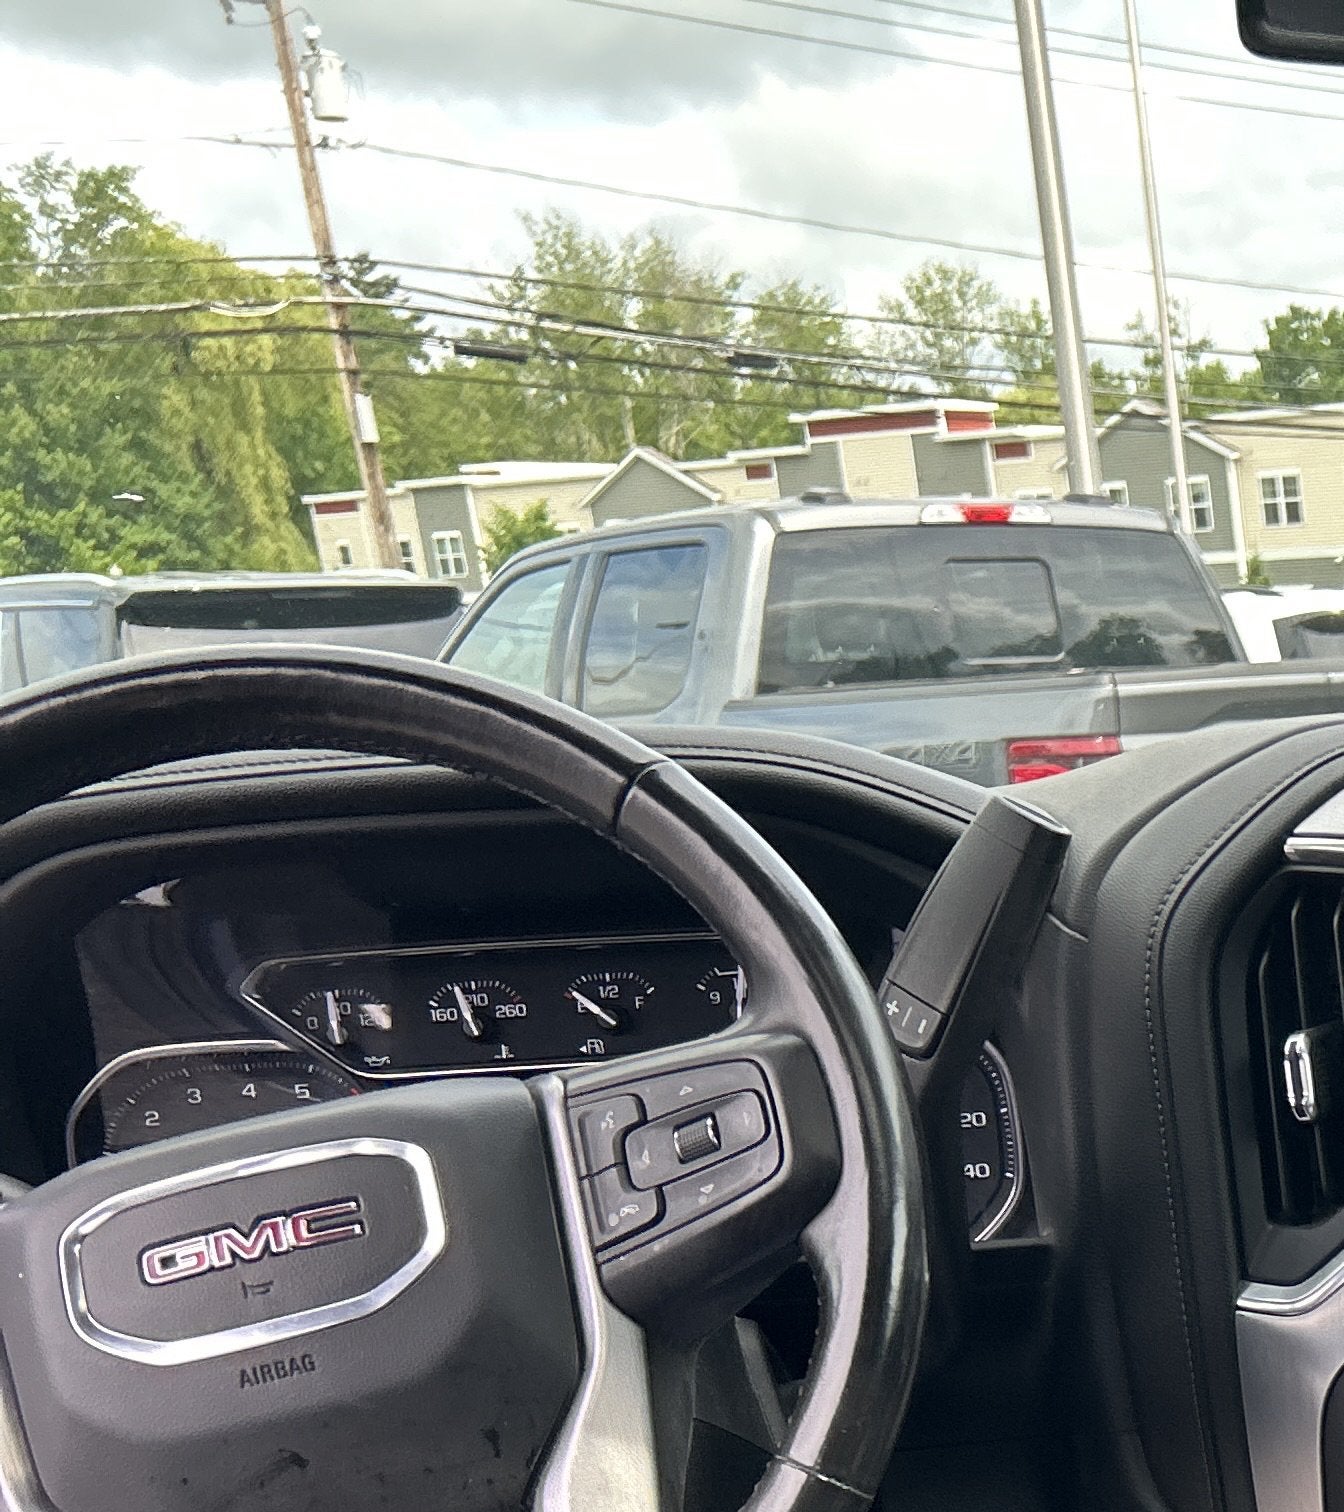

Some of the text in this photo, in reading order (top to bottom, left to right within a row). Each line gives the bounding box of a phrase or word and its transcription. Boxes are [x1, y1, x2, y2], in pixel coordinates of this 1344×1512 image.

[634, 995, 645, 1010] F
[709, 991, 721, 1005] 9
[430, 1007, 458, 1022] 160
[495, 1003, 527, 1019] 260
[306, 1016, 319, 1030] 0
[186, 1087, 202, 1104] 3
[241, 1083, 257, 1098] 4
[294, 1083, 311, 1099] 5
[144, 1110, 161, 1127] 2
[960, 1111, 987, 1128] 20
[963, 1162, 991, 1179] 40
[138, 1199, 365, 1286] GMC
[239, 1353, 317, 1389] AIRBAG
